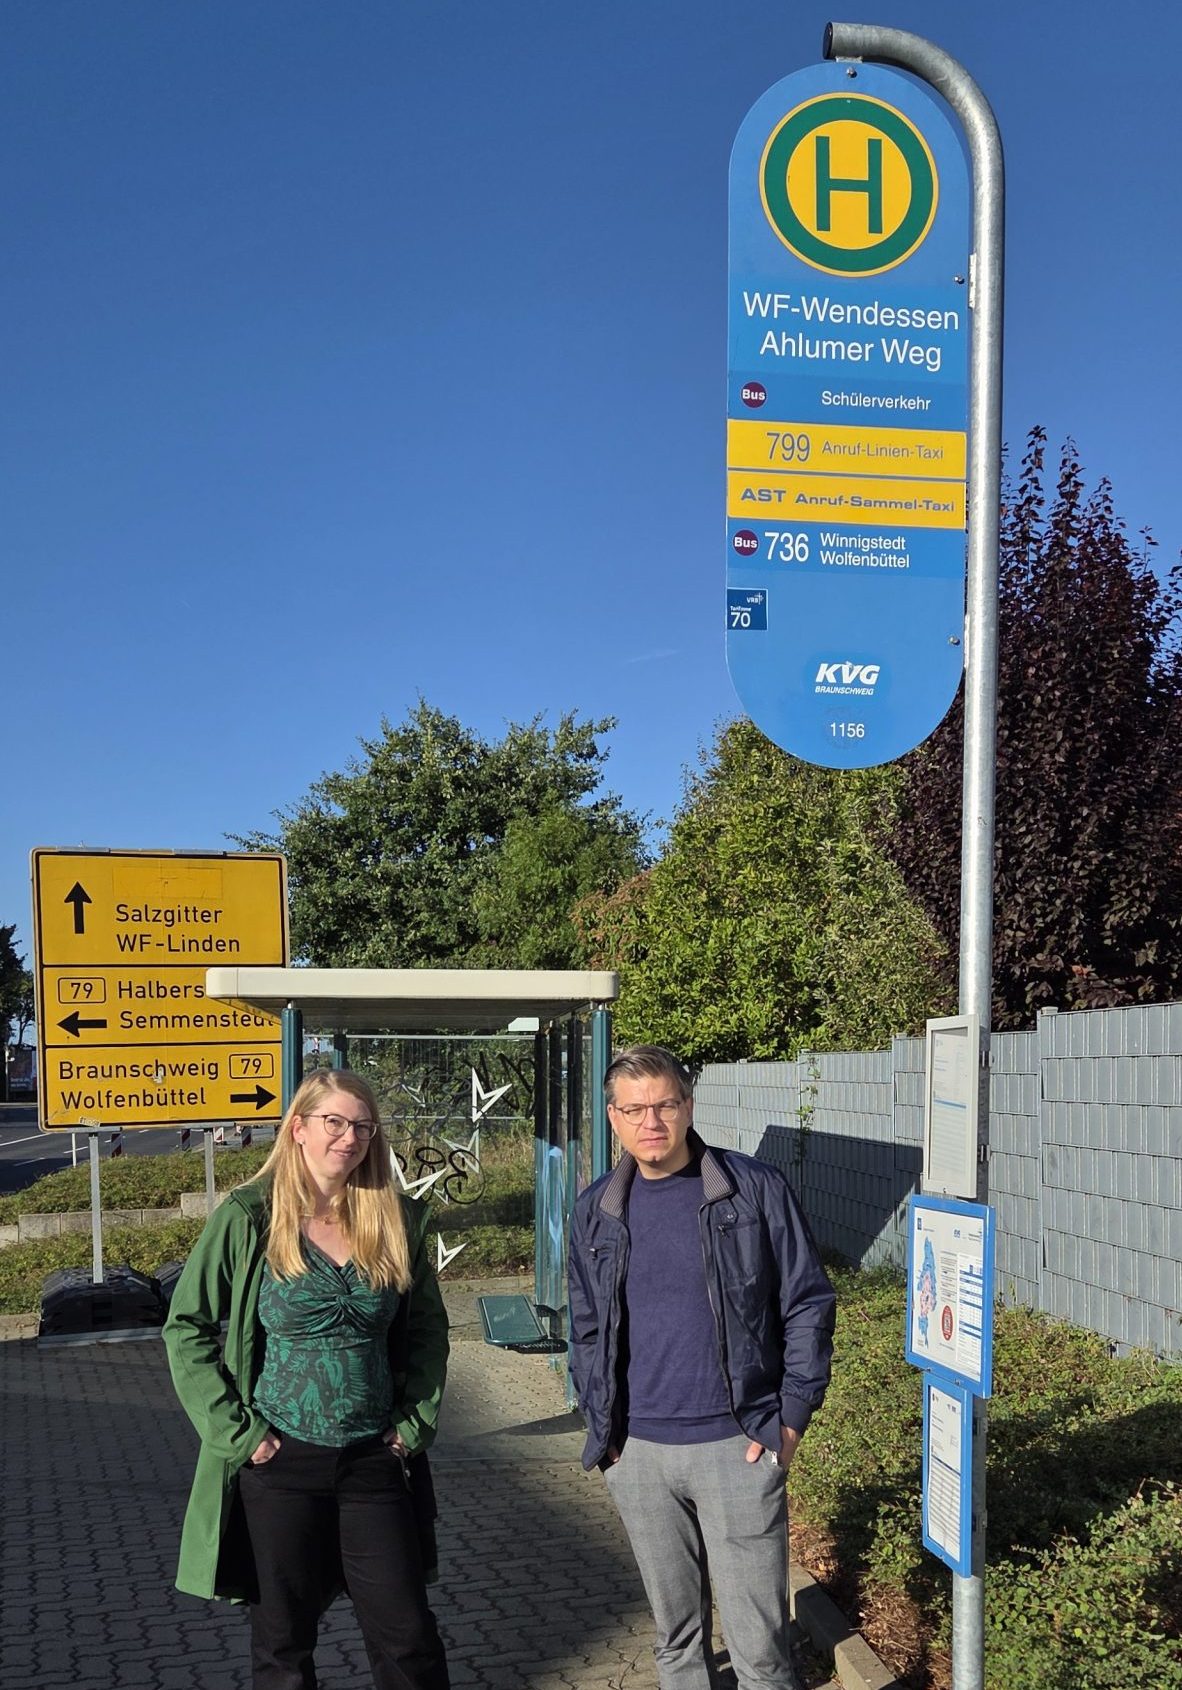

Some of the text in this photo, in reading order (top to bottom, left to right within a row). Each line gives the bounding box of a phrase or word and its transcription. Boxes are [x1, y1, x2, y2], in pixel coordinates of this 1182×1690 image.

[815, 135, 883, 235] H
[743, 290, 960, 330] WF-Wendessen
[759, 330, 942, 373] Ahlumer Weg
[742, 388, 766, 401] Bus
[821, 390, 931, 411] Schülerverkehr
[766, 432, 944, 463] 799 Anruf-Linien-Taxi
[740, 487, 955, 513] AST Anruf-Sammel-Taxi
[733, 536, 758, 549] Bus
[764, 532, 906, 562] 736 Winnigstedt
[819, 550, 910, 569] Wolfenbüttel
[730, 611, 751, 628] 70
[815, 661, 881, 685] KVG
[814, 685, 874, 696] BRAUNSCHWEIG
[830, 722, 865, 738] 1156
[116, 904, 223, 927] Salzgitter
[116, 934, 241, 953] WF-Linden
[70, 982, 94, 1000] 79
[58, 1058, 219, 1080] Braunschweig
[240, 1058, 262, 1075] 79
[60, 1087, 206, 1110] Wolfenbüttel
